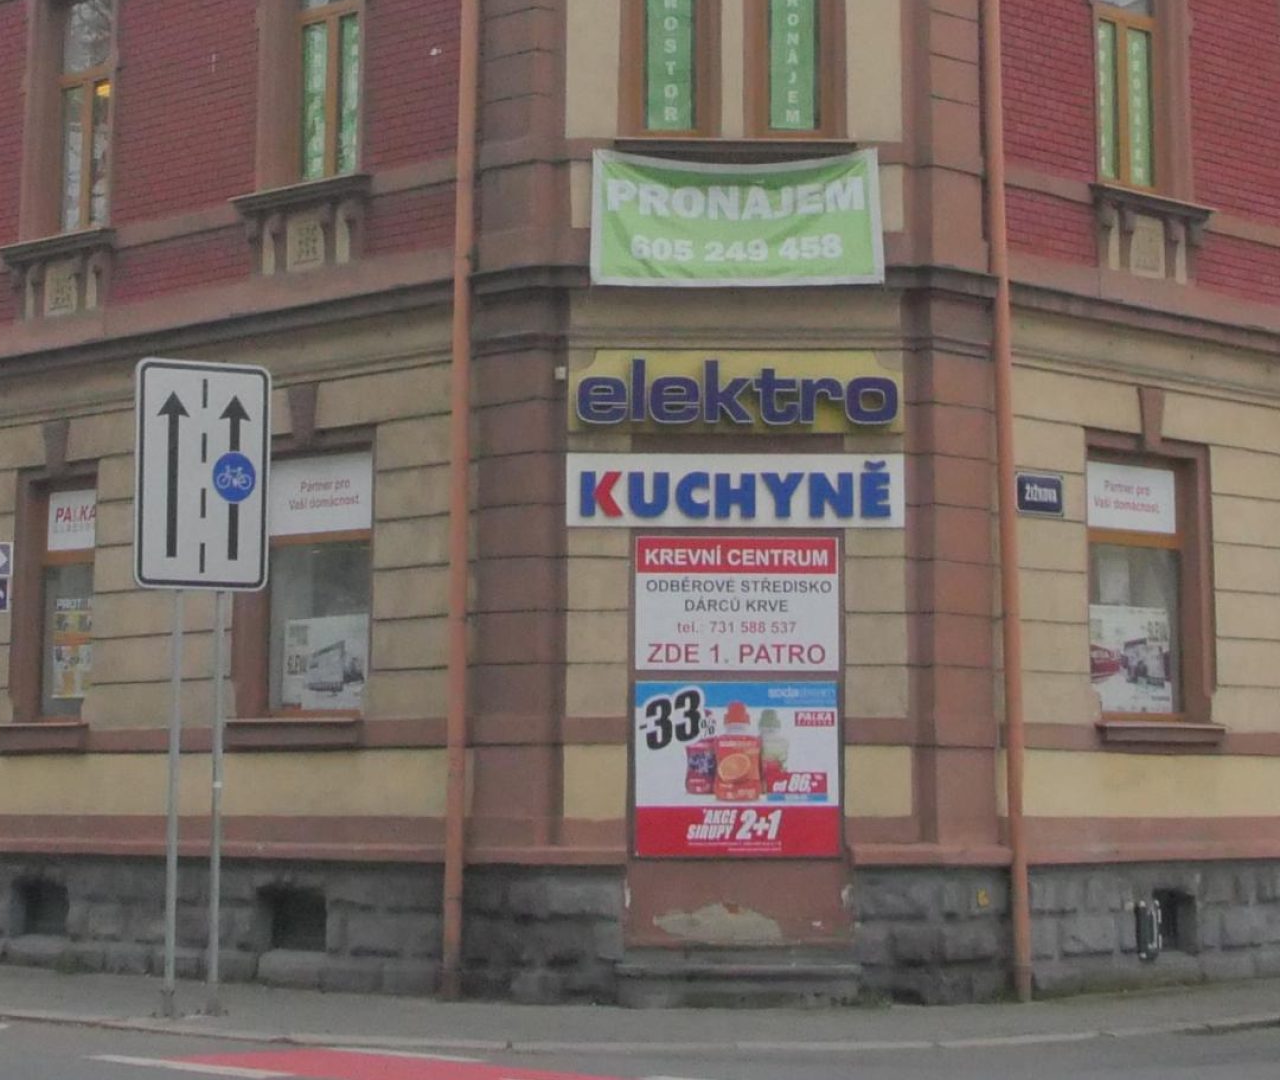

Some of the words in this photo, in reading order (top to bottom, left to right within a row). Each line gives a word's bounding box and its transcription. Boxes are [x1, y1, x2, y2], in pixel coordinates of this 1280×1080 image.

[631, 233, 694, 262] 605
[704, 236, 769, 263] 249
[778, 232, 843, 260] 458
[576, 357, 899, 425] elektro
[579, 460, 891, 519] KUCHYNĚ
[644, 544, 721, 566] KREVNÍ
[727, 548, 828, 567] CENTRUM
[646, 576, 735, 593] ODBĚROVÉ
[740, 576, 832, 594] STŘEDISKO
[684, 596, 741, 613] DÁRCŮ
[746, 599, 789, 613] KRVE
[709, 621, 735, 634] 731
[771, 621, 797, 634] 537
[647, 643, 700, 664] ZDE
[708, 643, 730, 664] 1.
[739, 643, 826, 664] PATRO
[686, 823, 735, 839] SIRUPY
[736, 808, 783, 840] 2+1
